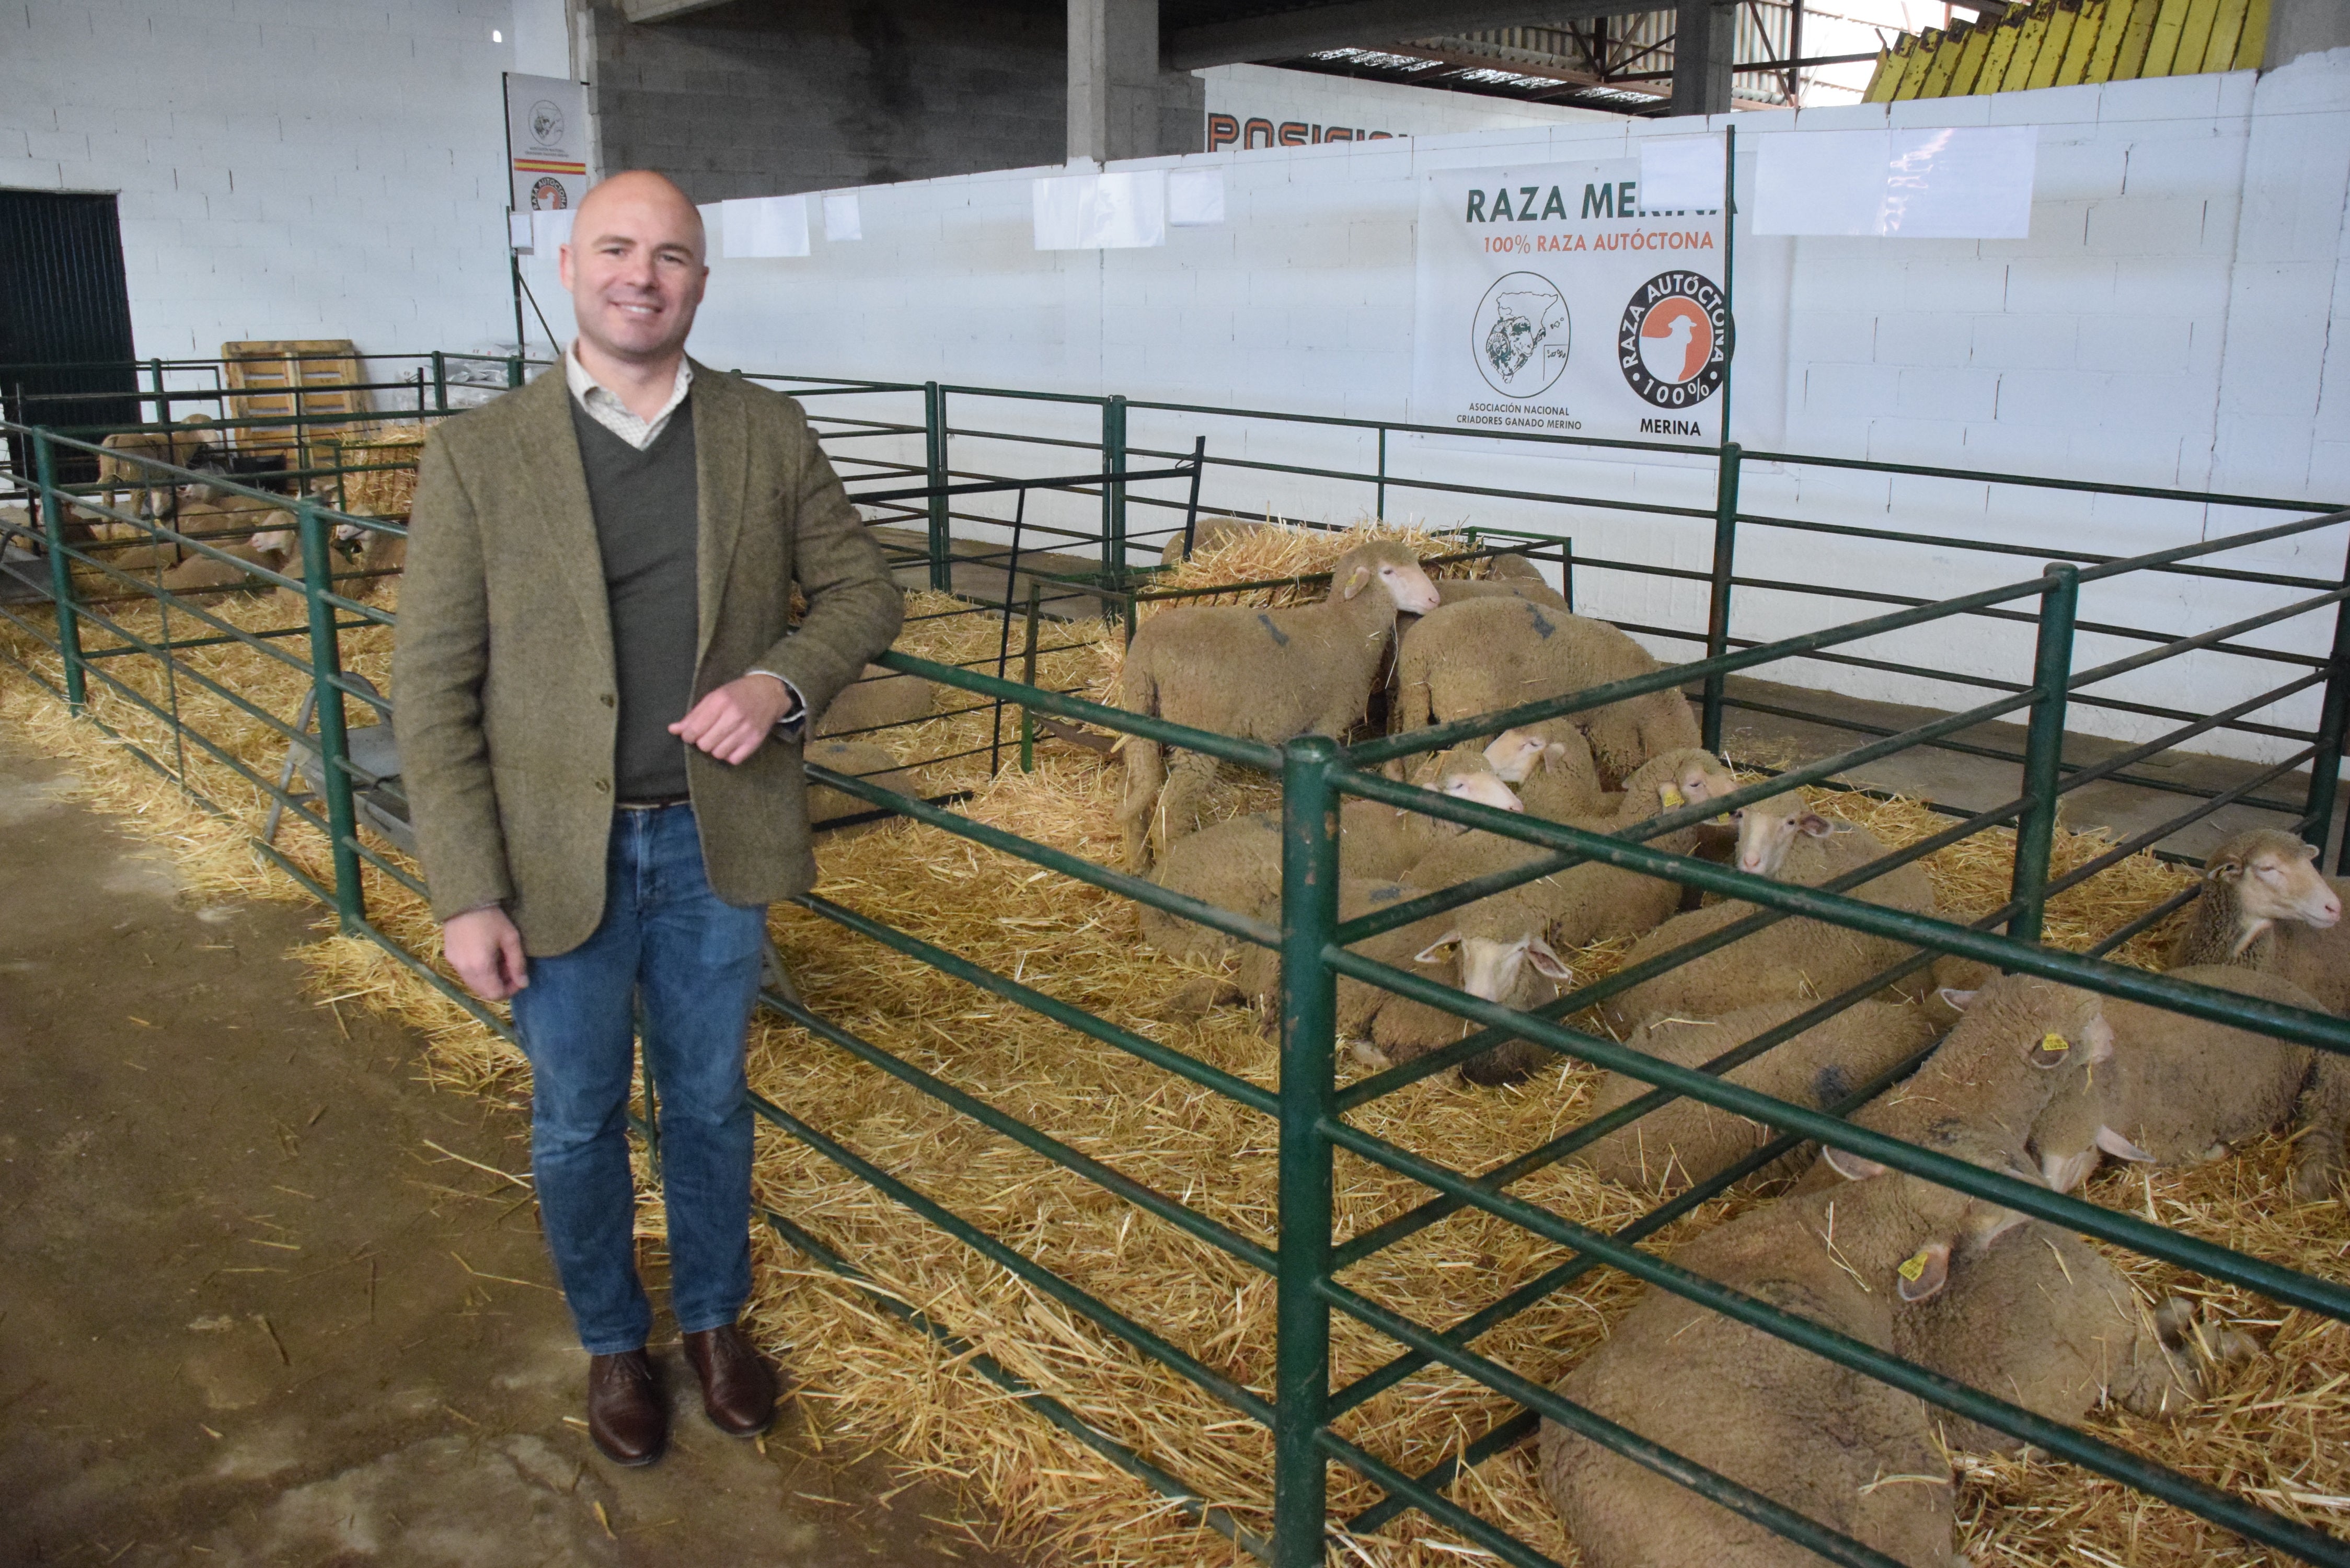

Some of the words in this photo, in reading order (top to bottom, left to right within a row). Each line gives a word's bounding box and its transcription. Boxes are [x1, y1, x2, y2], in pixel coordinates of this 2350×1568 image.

[1466, 185, 1568, 223] RAZA
[1484, 234, 1530, 255] 100%
[1537, 234, 1587, 252] RAZA
[1593, 228, 1714, 251] AUTÓCTONA
[1621, 305, 1645, 369] RAZA
[1643, 377, 1709, 405] 100%
[1456, 414, 1503, 425] CRIADORES
[1505, 417, 1545, 428] GANADO
[1547, 419, 1582, 430] MERINO
[1469, 402, 1522, 413] ASOCIACIÓN
[1524, 405, 1570, 416] NACIONAL
[1640, 418, 1701, 436] MERINA
